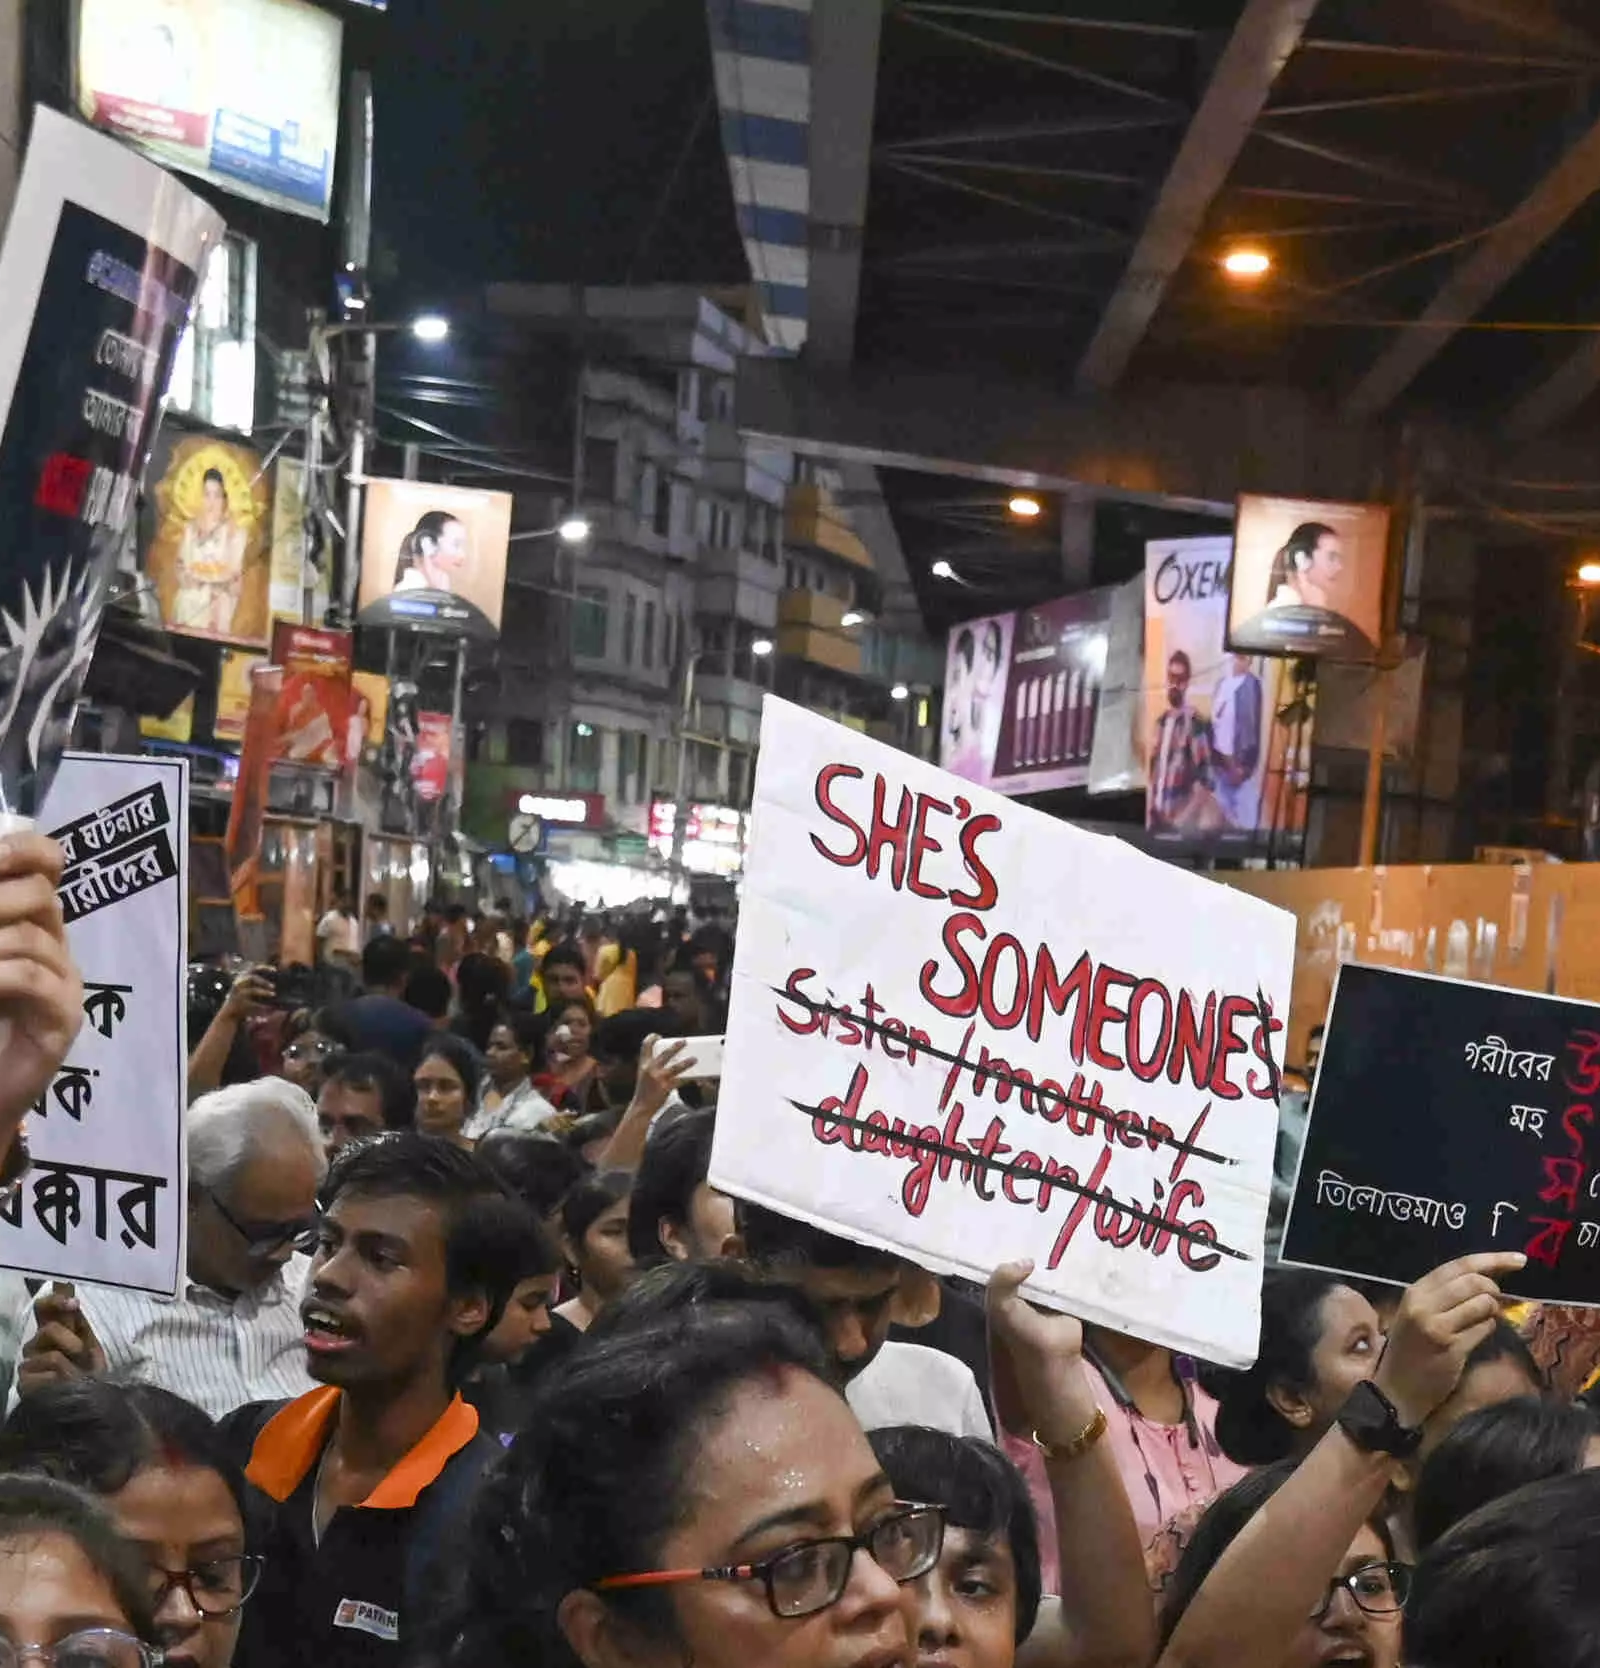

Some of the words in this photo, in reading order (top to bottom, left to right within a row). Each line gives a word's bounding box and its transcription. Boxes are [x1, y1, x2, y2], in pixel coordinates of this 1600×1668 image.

[811, 764, 1002, 911] SHE'S
[1464, 1035, 1555, 1081] গরীবের
[1316, 1168, 1467, 1231] তিলোত্তমাও
